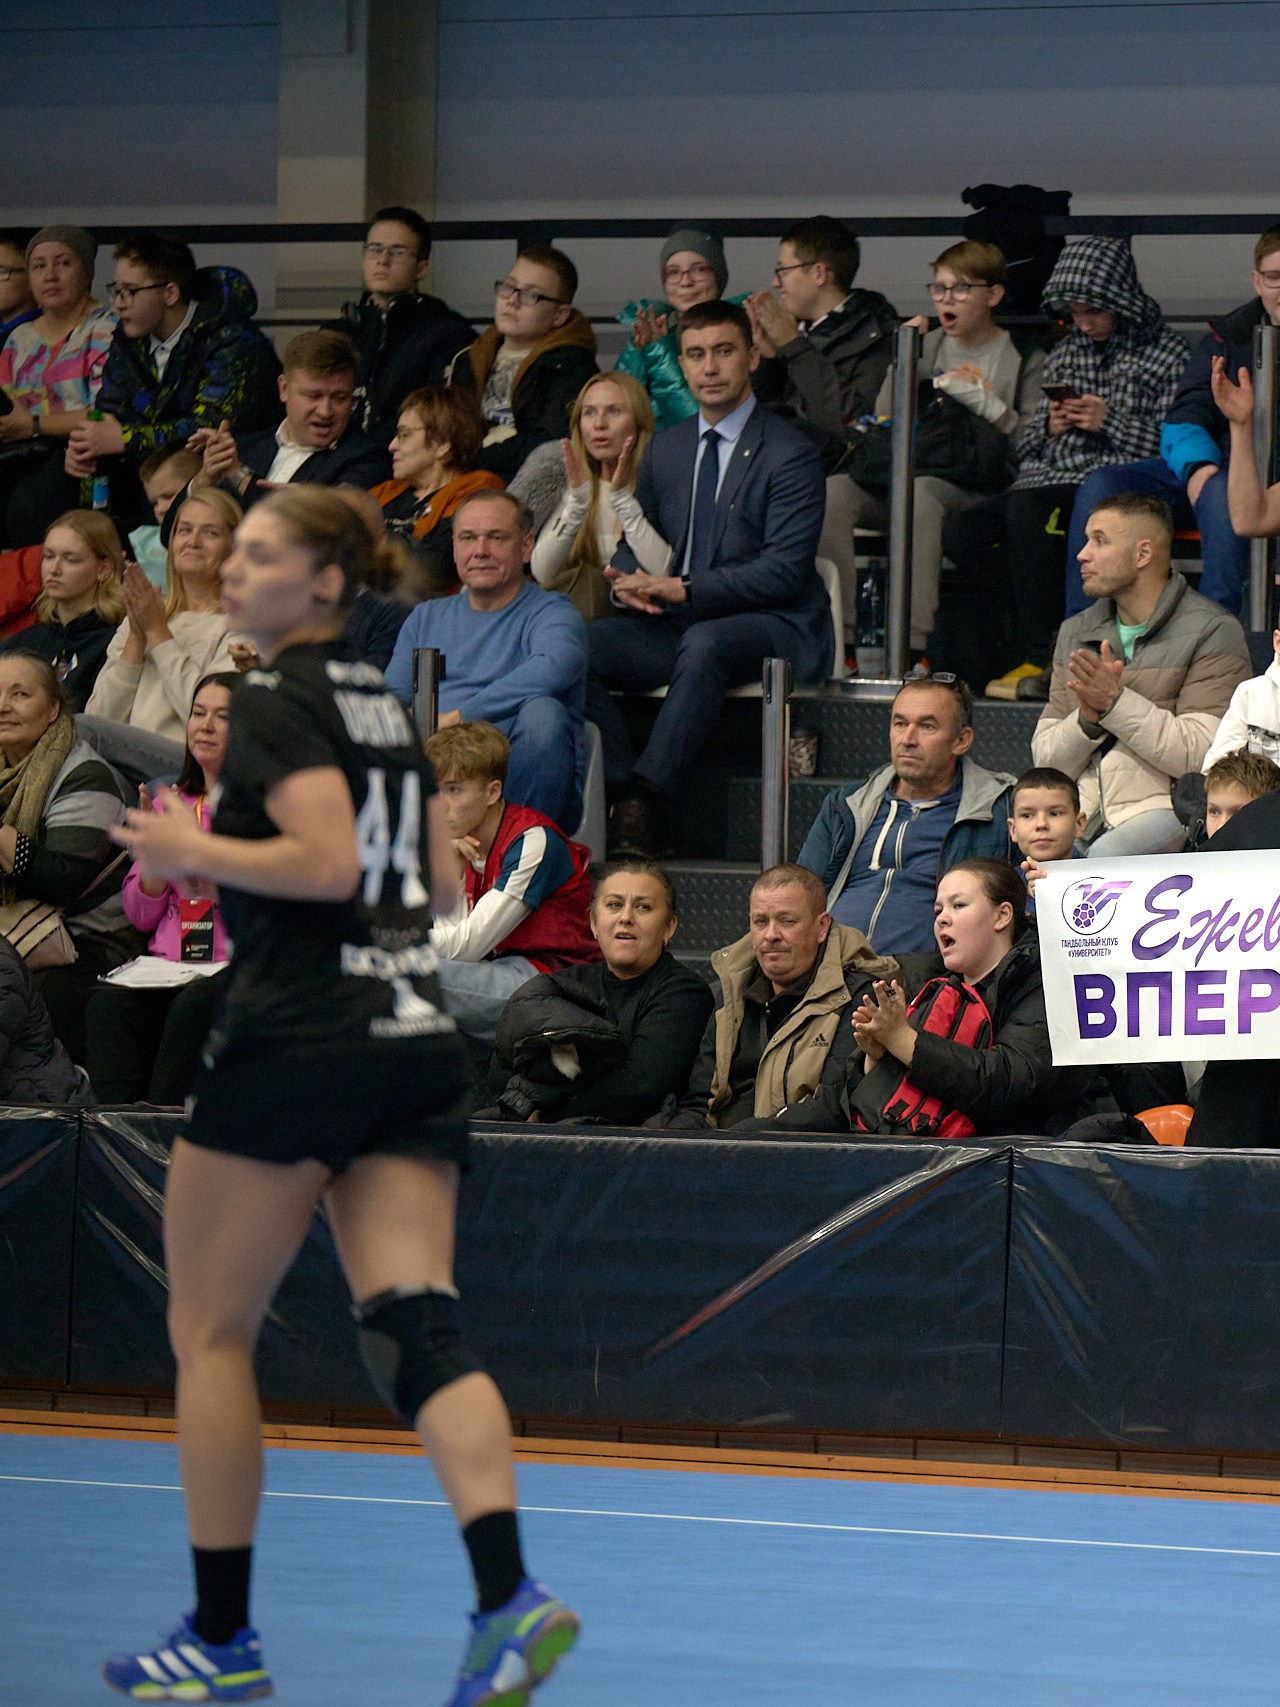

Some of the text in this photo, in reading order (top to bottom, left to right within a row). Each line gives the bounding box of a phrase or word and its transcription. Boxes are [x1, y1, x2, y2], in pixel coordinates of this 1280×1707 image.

[355, 766, 430, 910] 44
[1061, 937, 1119, 948] ГАНДБОЛЬНЫЙ КЛУБ
[1068, 948, 1111, 958] «УНИВЕРСИТЕТ»
